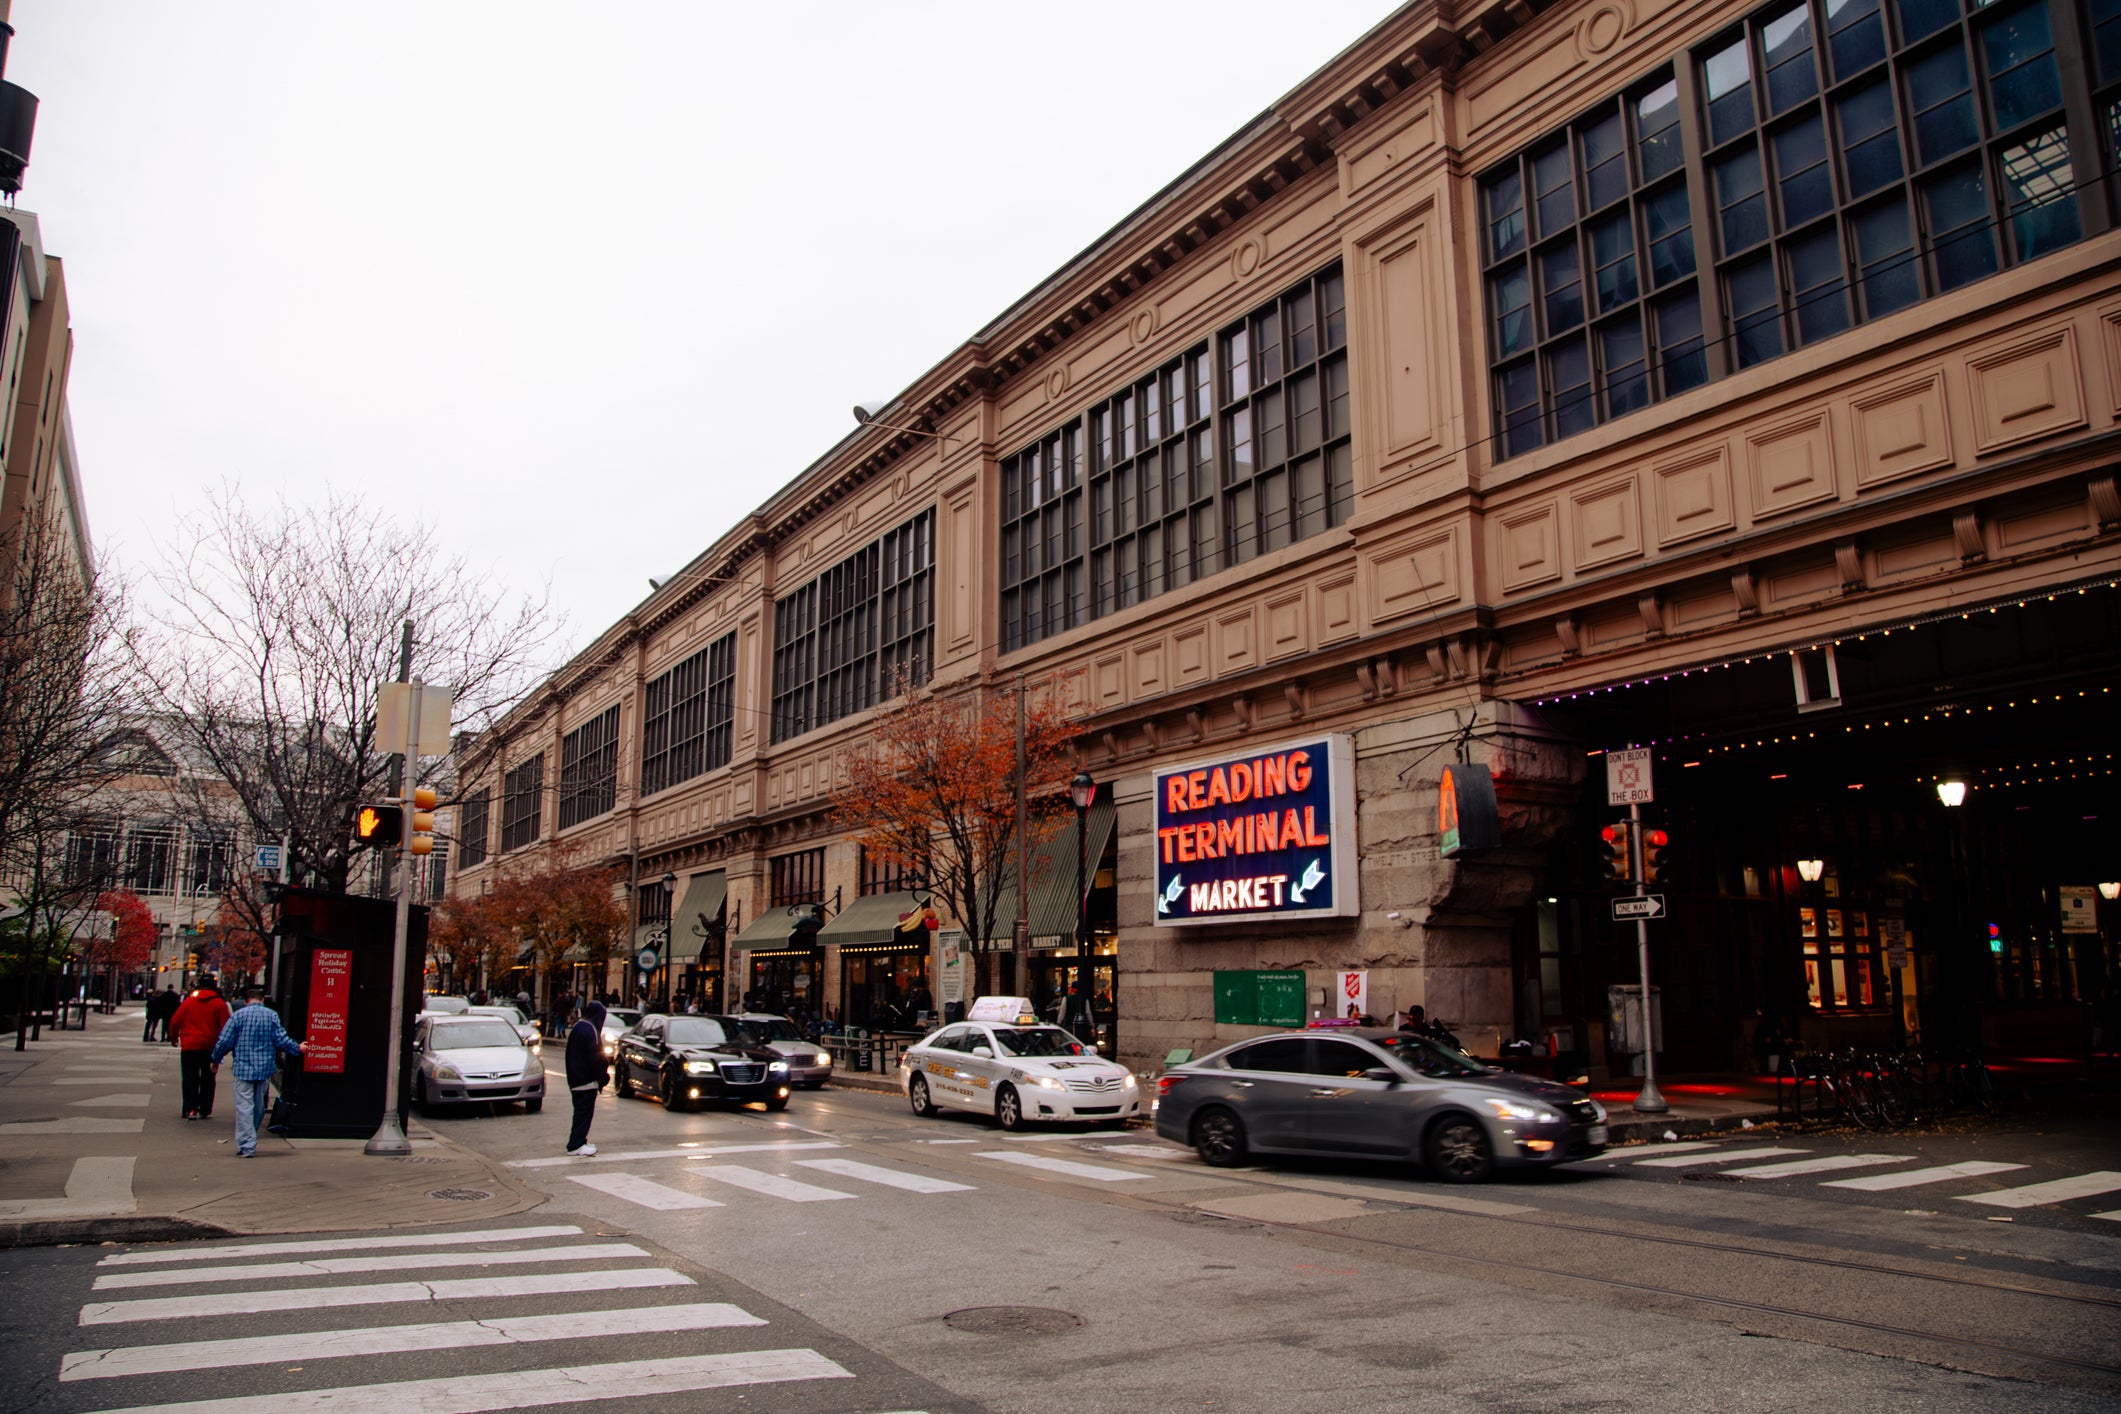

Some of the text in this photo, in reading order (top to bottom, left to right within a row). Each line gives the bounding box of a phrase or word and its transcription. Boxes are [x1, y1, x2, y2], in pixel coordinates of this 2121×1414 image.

[1628, 751, 1648, 761] BLOCK
[1167, 751, 1312, 813] READING
[1611, 789, 1649, 802] THE BOX
[1158, 805, 1330, 864] TERMINAL
[1190, 874, 1289, 912] MARKET
[1618, 902, 1648, 913] ONE WAY
[320, 951, 347, 960] Spread
[928, 1062, 942, 1075] 215
